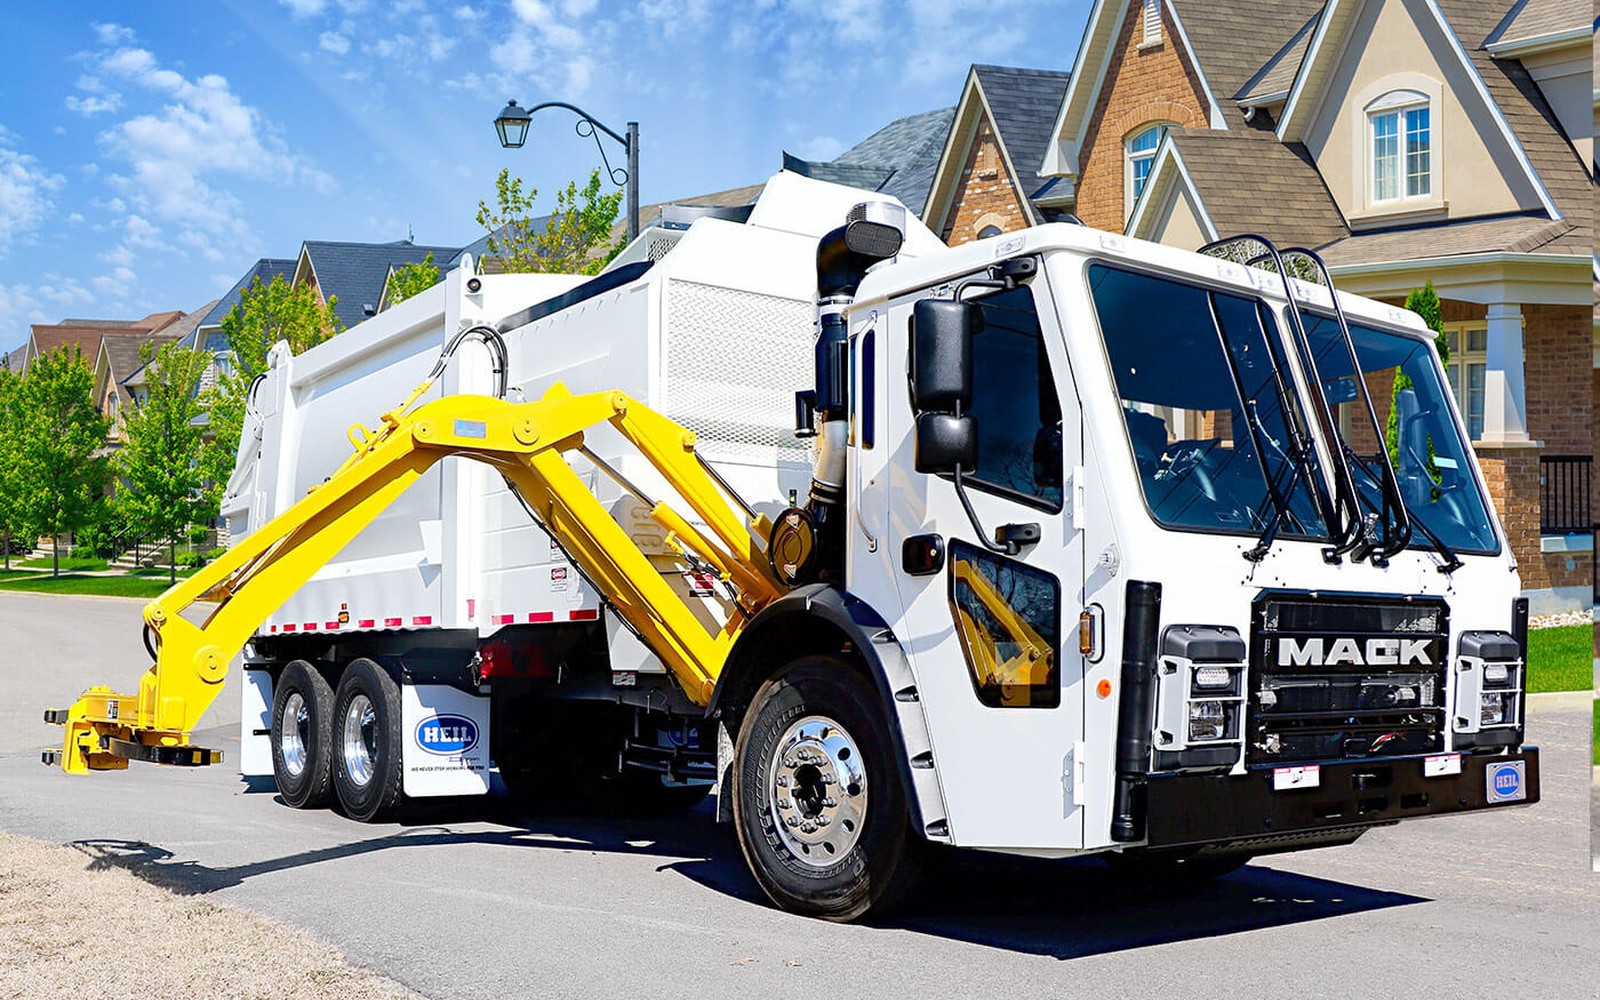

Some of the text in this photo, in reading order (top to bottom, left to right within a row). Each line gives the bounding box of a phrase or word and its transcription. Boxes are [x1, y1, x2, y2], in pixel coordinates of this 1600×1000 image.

[1278, 638, 1433, 666] MACK
[424, 726, 472, 742] HEIL
[1496, 774, 1518, 788] HEIL
